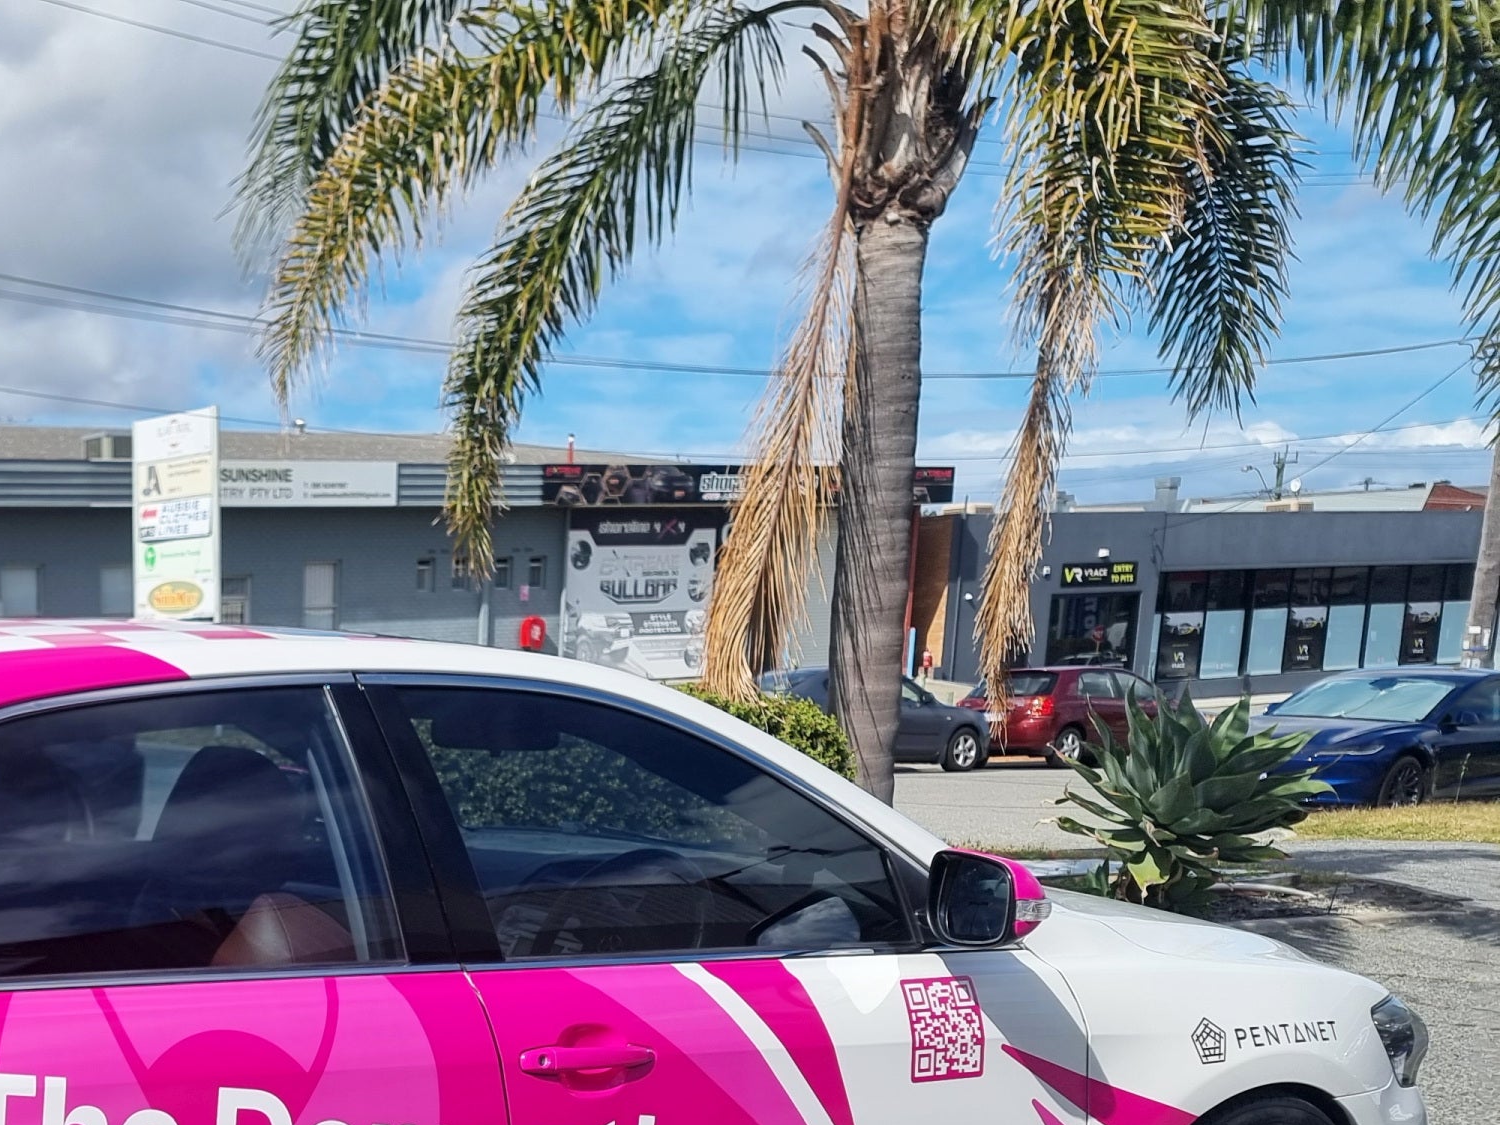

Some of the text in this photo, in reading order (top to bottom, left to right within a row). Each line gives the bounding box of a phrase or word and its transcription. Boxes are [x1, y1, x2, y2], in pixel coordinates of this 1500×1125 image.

[220, 467, 293, 483] SUNSHINE
[598, 520, 651, 534] shoreline
[1065, 567, 1083, 583] VR
[1113, 563, 1134, 573] ENTRY
[1111, 573, 1134, 583] TO PITS
[600, 578, 678, 600] BULLBAR
